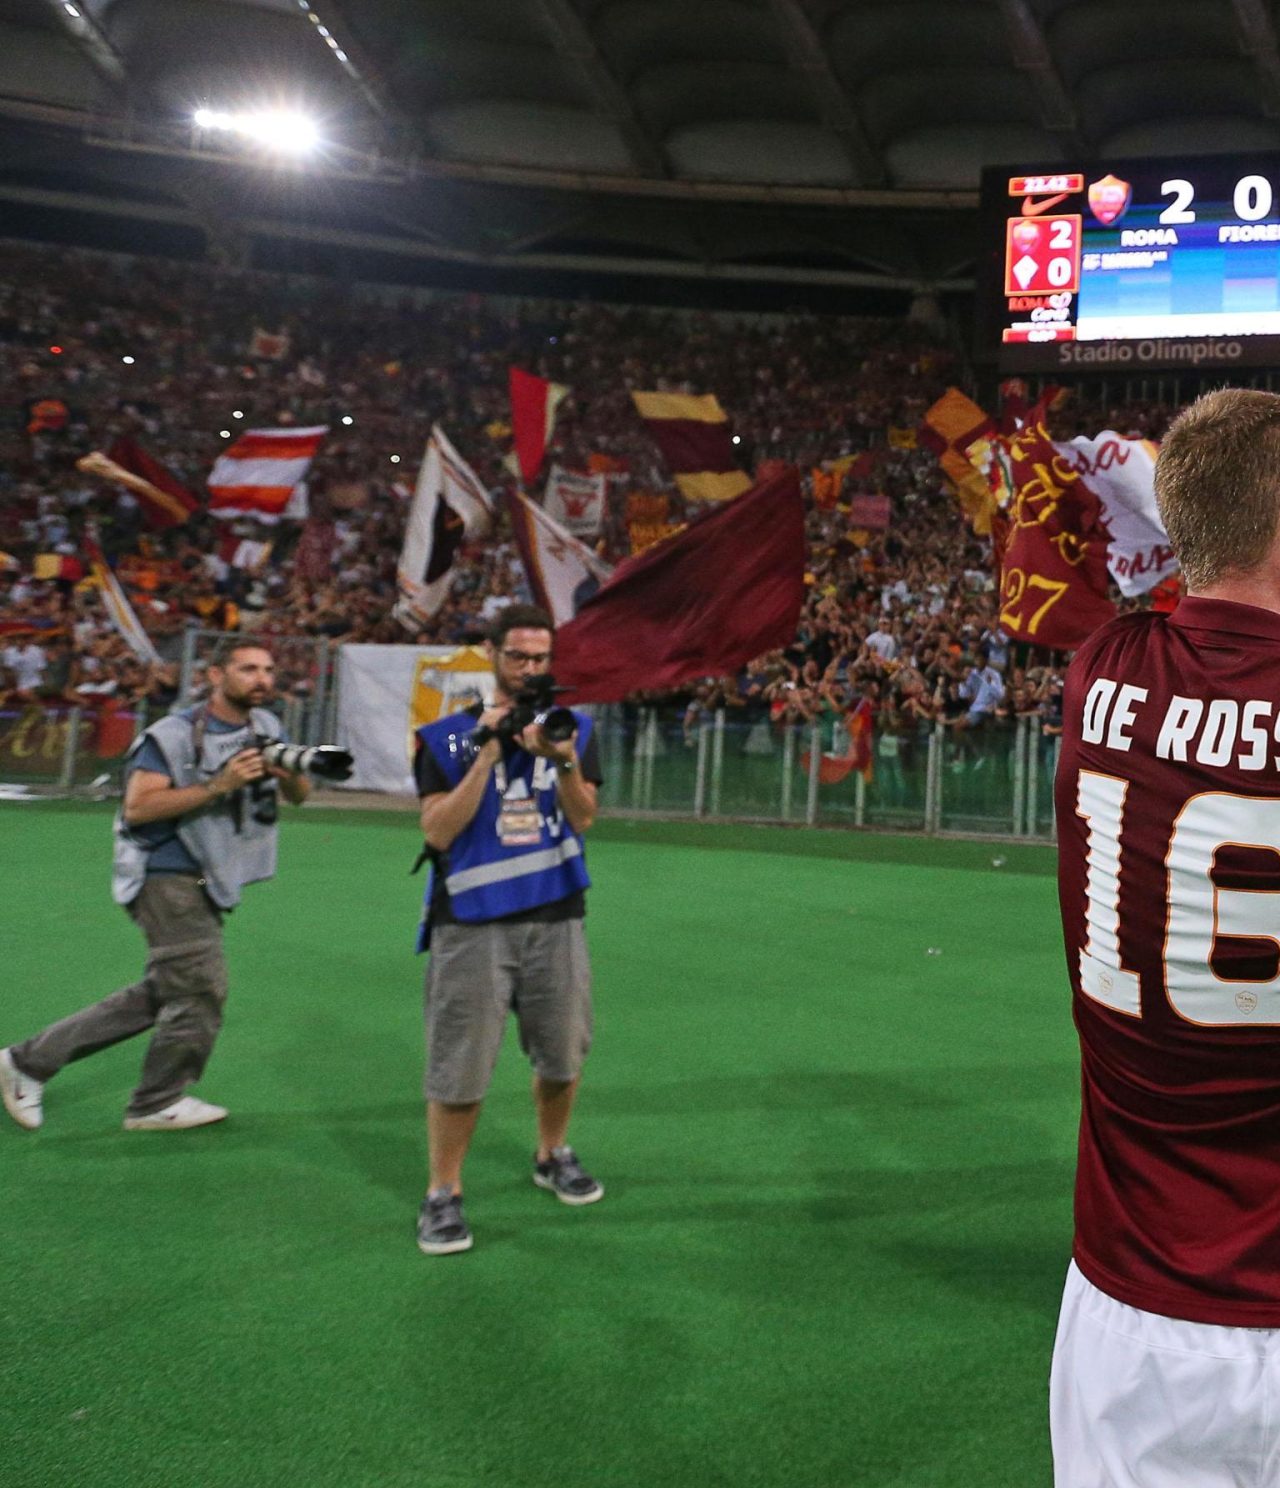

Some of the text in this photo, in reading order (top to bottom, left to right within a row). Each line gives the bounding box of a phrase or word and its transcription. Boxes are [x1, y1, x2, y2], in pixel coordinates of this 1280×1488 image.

[1159, 174, 1273, 225] 2 0
[1049, 220, 1073, 250] 2
[1120, 228, 1179, 248] ROMA
[1047, 256, 1072, 287] 0
[1059, 338, 1243, 364] Stadio Olimpico
[1081, 677, 1149, 752] DE
